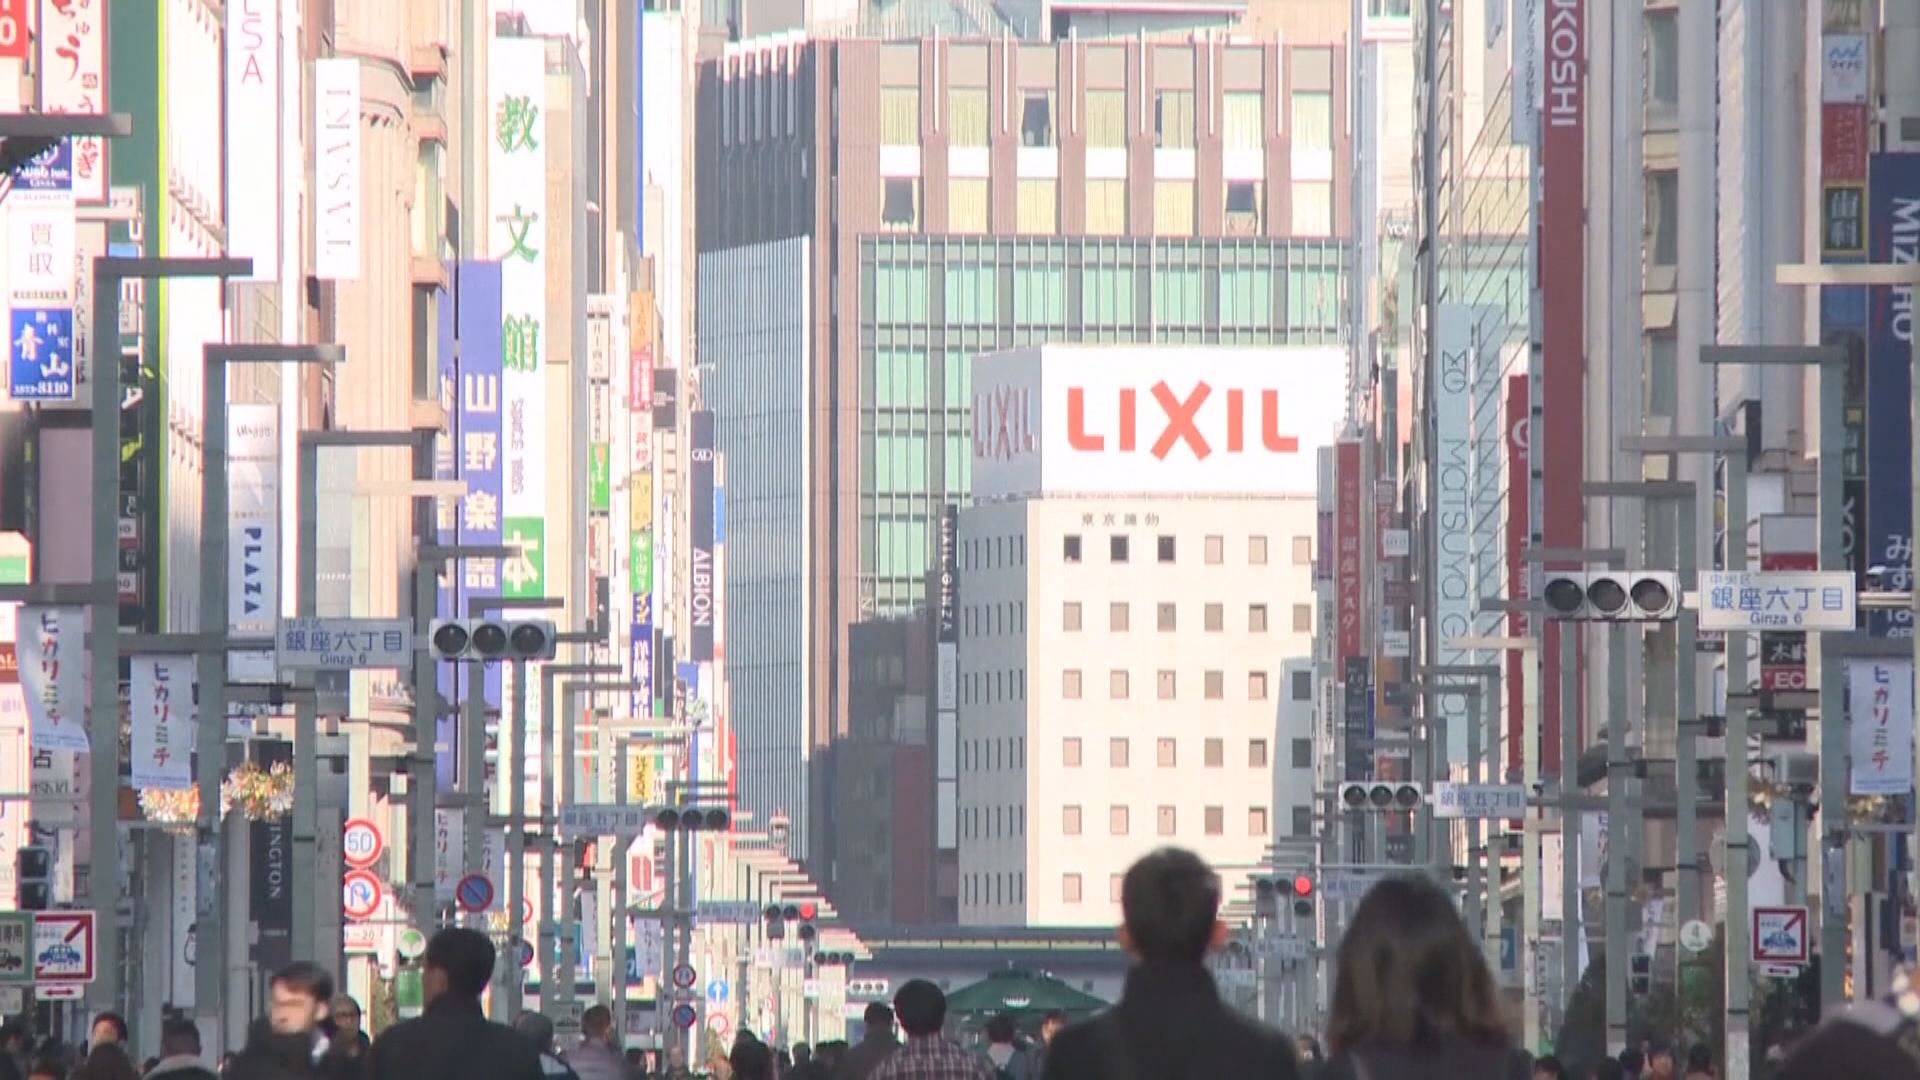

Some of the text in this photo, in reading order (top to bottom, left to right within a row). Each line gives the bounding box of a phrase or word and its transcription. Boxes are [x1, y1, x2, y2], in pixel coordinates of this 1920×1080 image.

[326, 88, 352, 255] TASAKI
[496, 94, 540, 372] 教文館
[1892, 198, 1920, 342] MIZHO
[13, 323, 70, 379] 青山
[973, 382, 1036, 462] LIXIL
[1067, 379, 1299, 462] LIXIL
[464, 373, 498, 589] 山野楽器
[243, 527, 263, 615] PLAZA
[693, 547, 711, 628] ALBION
[1710, 586, 1844, 612] 銀座六丁目
[286, 629, 403, 652] 銀座六丁目
[319, 652, 368, 666] Ginza 6
[1750, 611, 1803, 626] Ginza 6
[152, 662, 171, 769] ヒカリミチ
[1870, 664, 1891, 773] ヒカリミチ
[347, 831, 373, 854] 50
